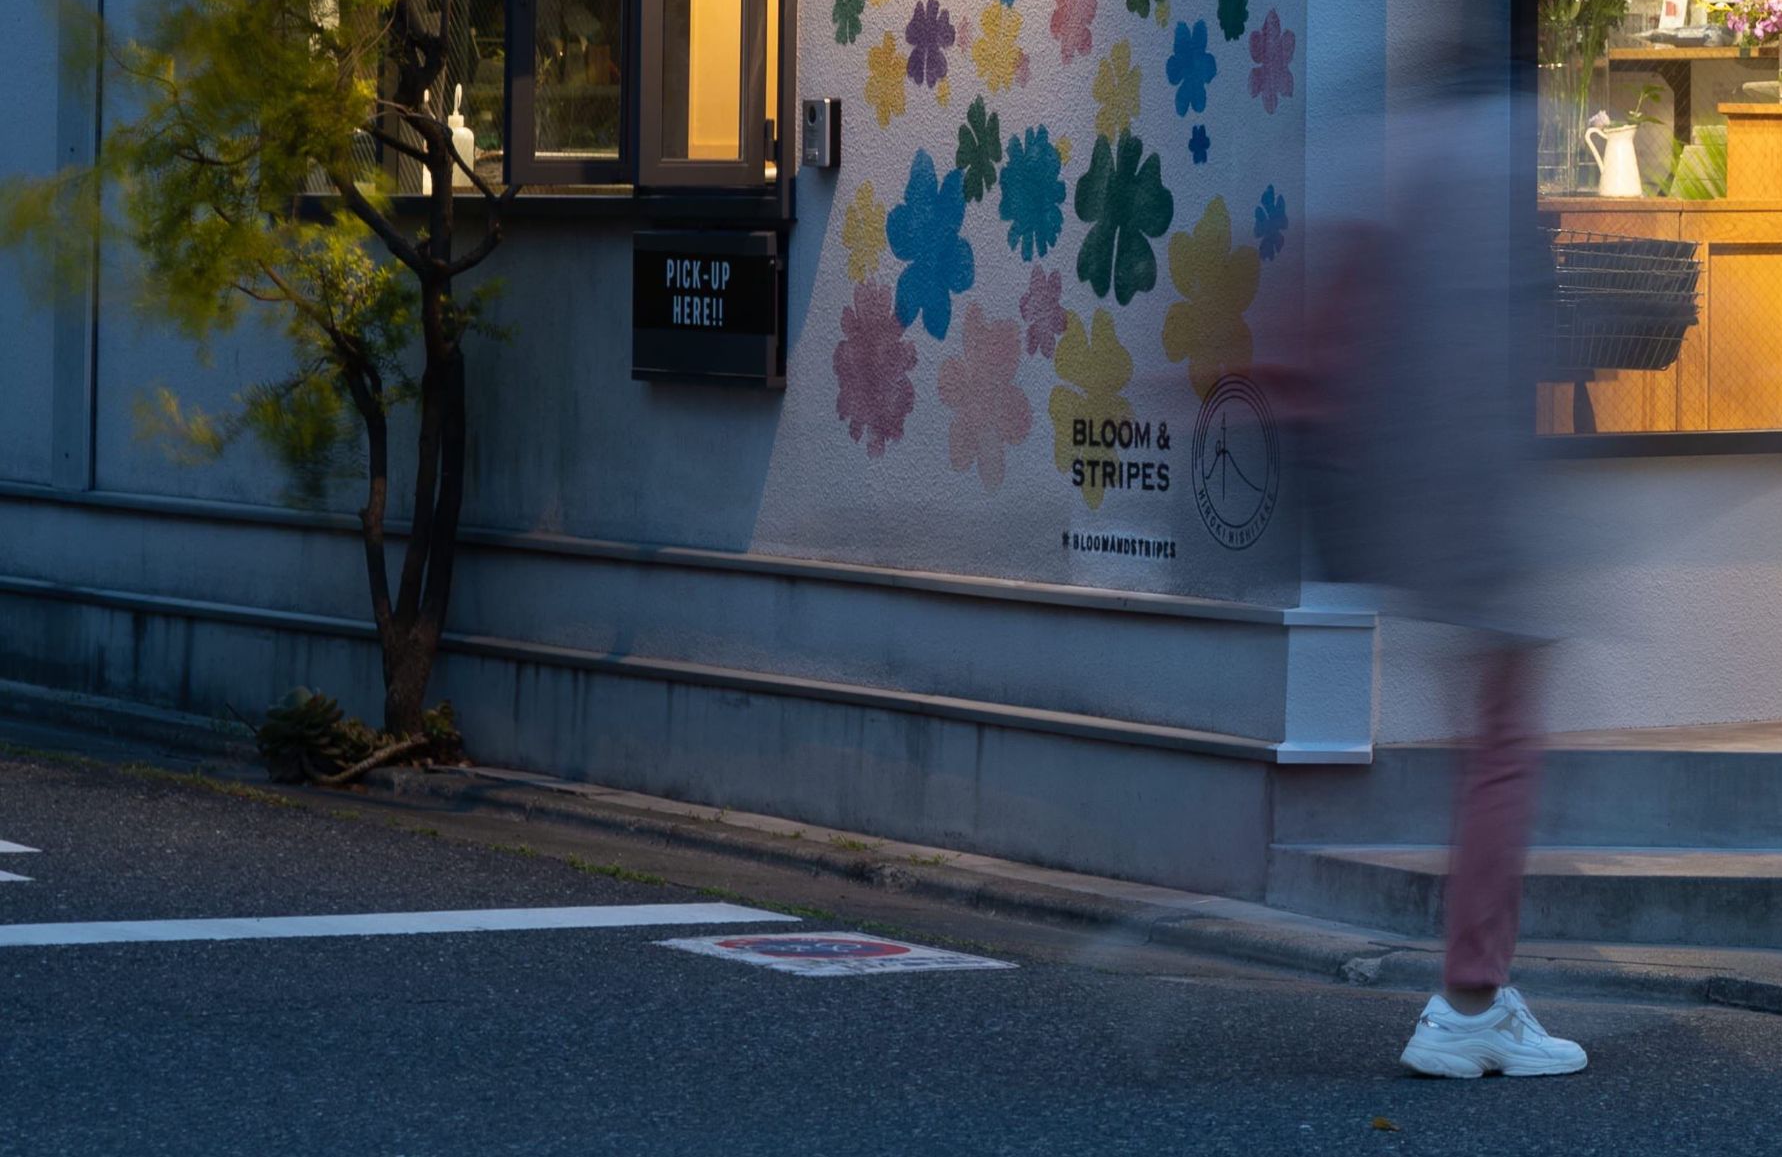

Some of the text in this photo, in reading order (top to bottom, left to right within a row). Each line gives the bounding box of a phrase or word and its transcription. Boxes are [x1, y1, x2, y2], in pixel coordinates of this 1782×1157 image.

[666, 258, 730, 290] PICK-UP
[673, 295, 723, 327] HERE!!
[1073, 419, 1171, 450] BLOOM &
[1072, 458, 1170, 492] STRIPES
